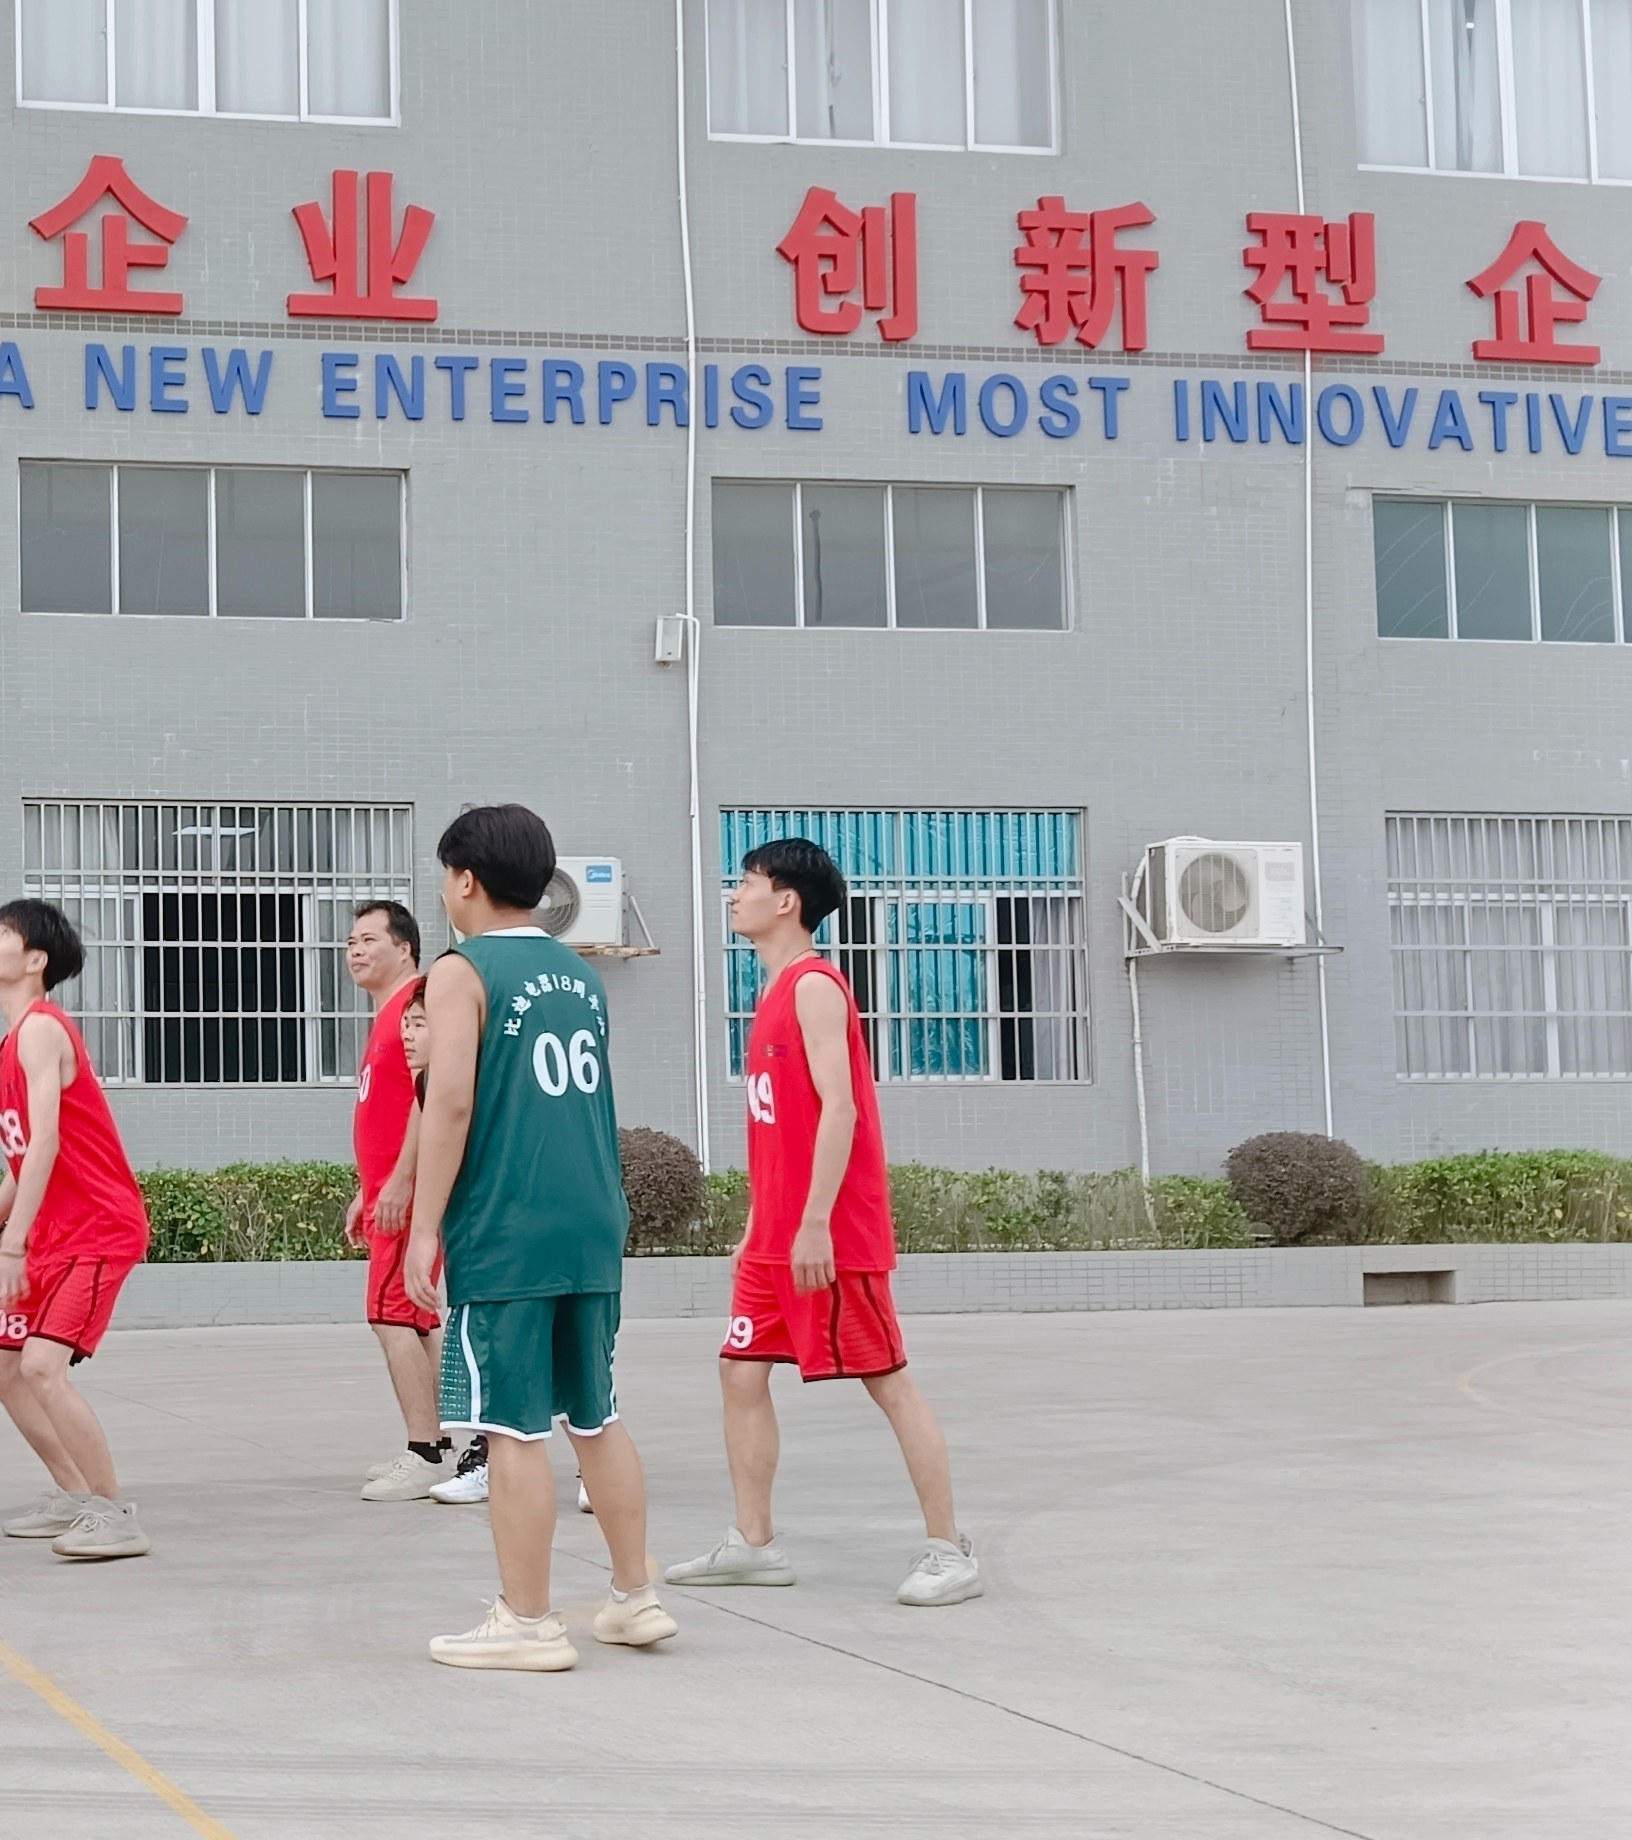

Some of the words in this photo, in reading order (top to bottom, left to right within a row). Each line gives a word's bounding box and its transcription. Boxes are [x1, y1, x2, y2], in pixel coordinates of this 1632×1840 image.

[776, 186, 1602, 366] 创新型企
[85, 344, 274, 416] NEW
[321, 352, 824, 432] ENTERPRISE
[907, 371, 1130, 440] MOST
[1174, 380, 1632, 458] INNOVATIVE
[532, 1029, 601, 1097] 06
